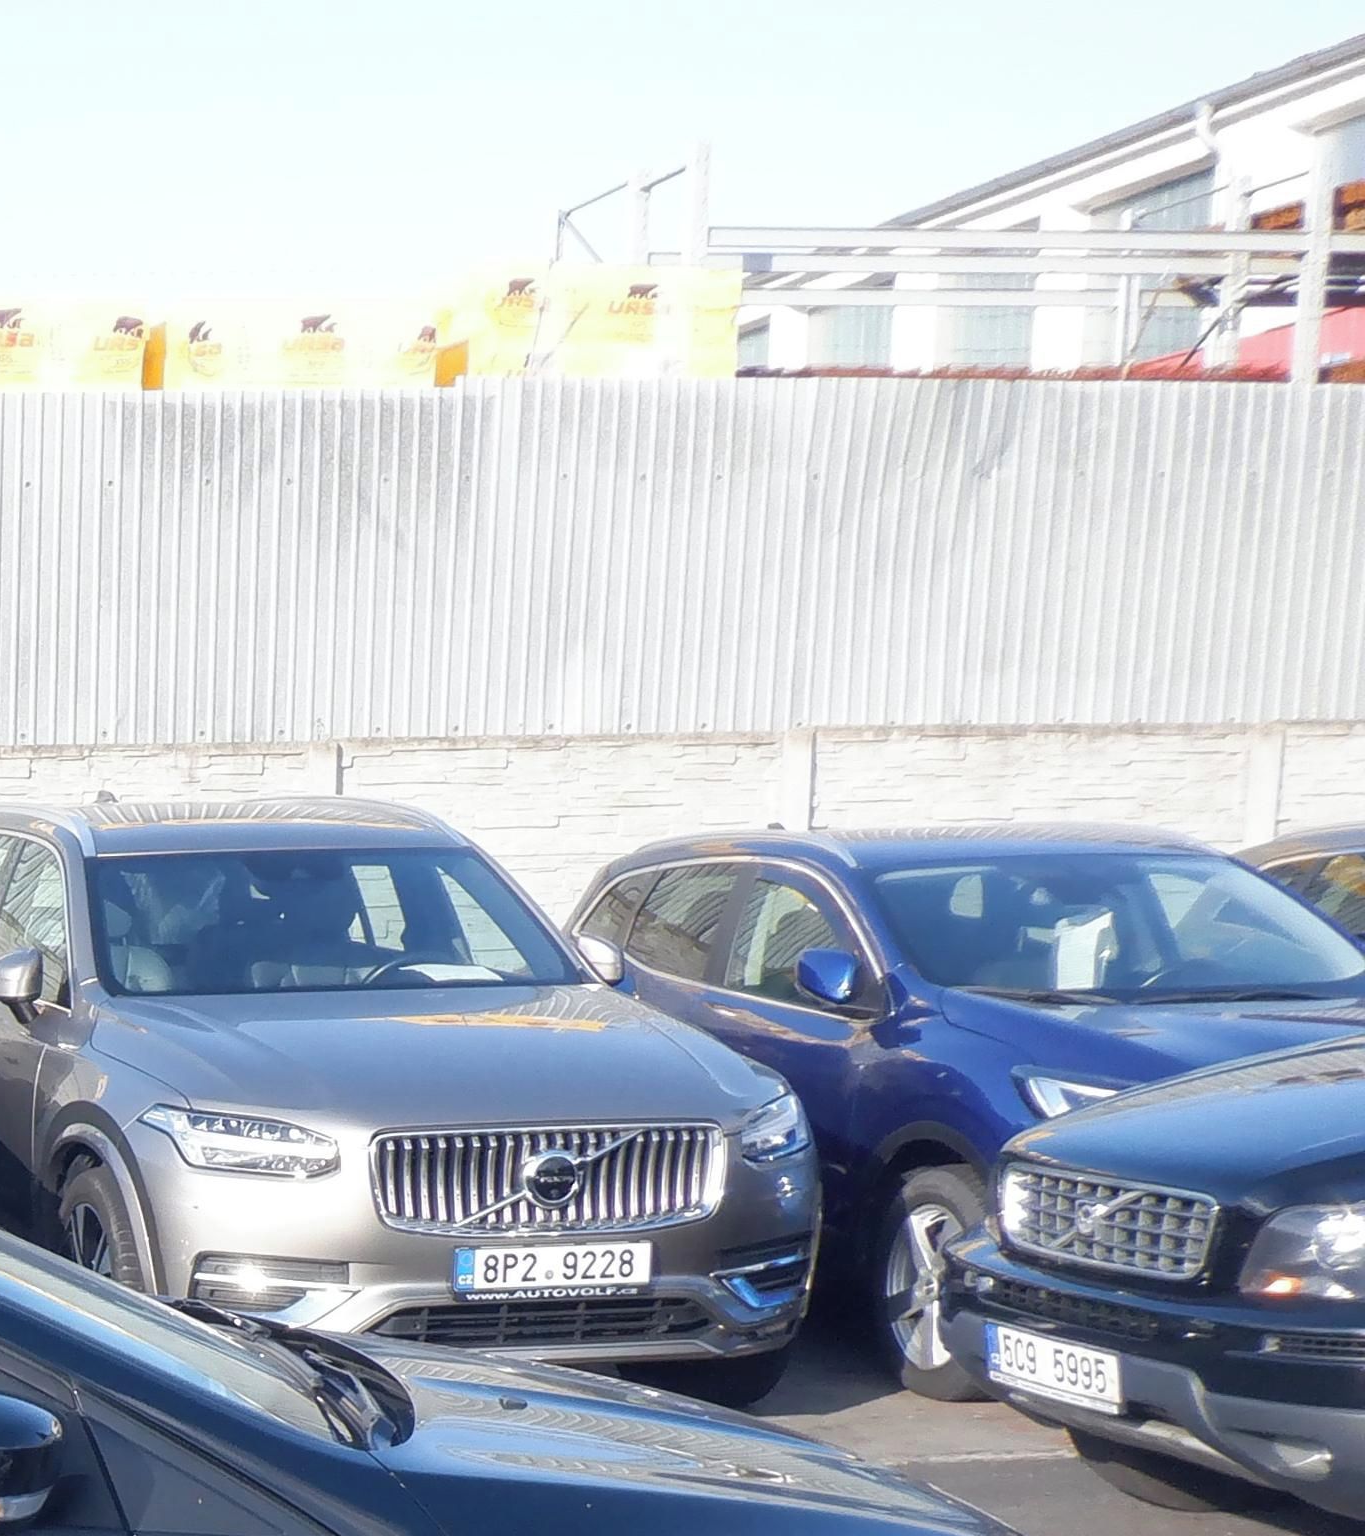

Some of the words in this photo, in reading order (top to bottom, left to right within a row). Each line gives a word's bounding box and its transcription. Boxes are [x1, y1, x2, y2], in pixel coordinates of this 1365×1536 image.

[483, 1253, 538, 1284] 8P2
[562, 1249, 635, 1281] 9228
[1002, 1334, 1037, 1375] 5C9
[1052, 1347, 1107, 1394] 5995
